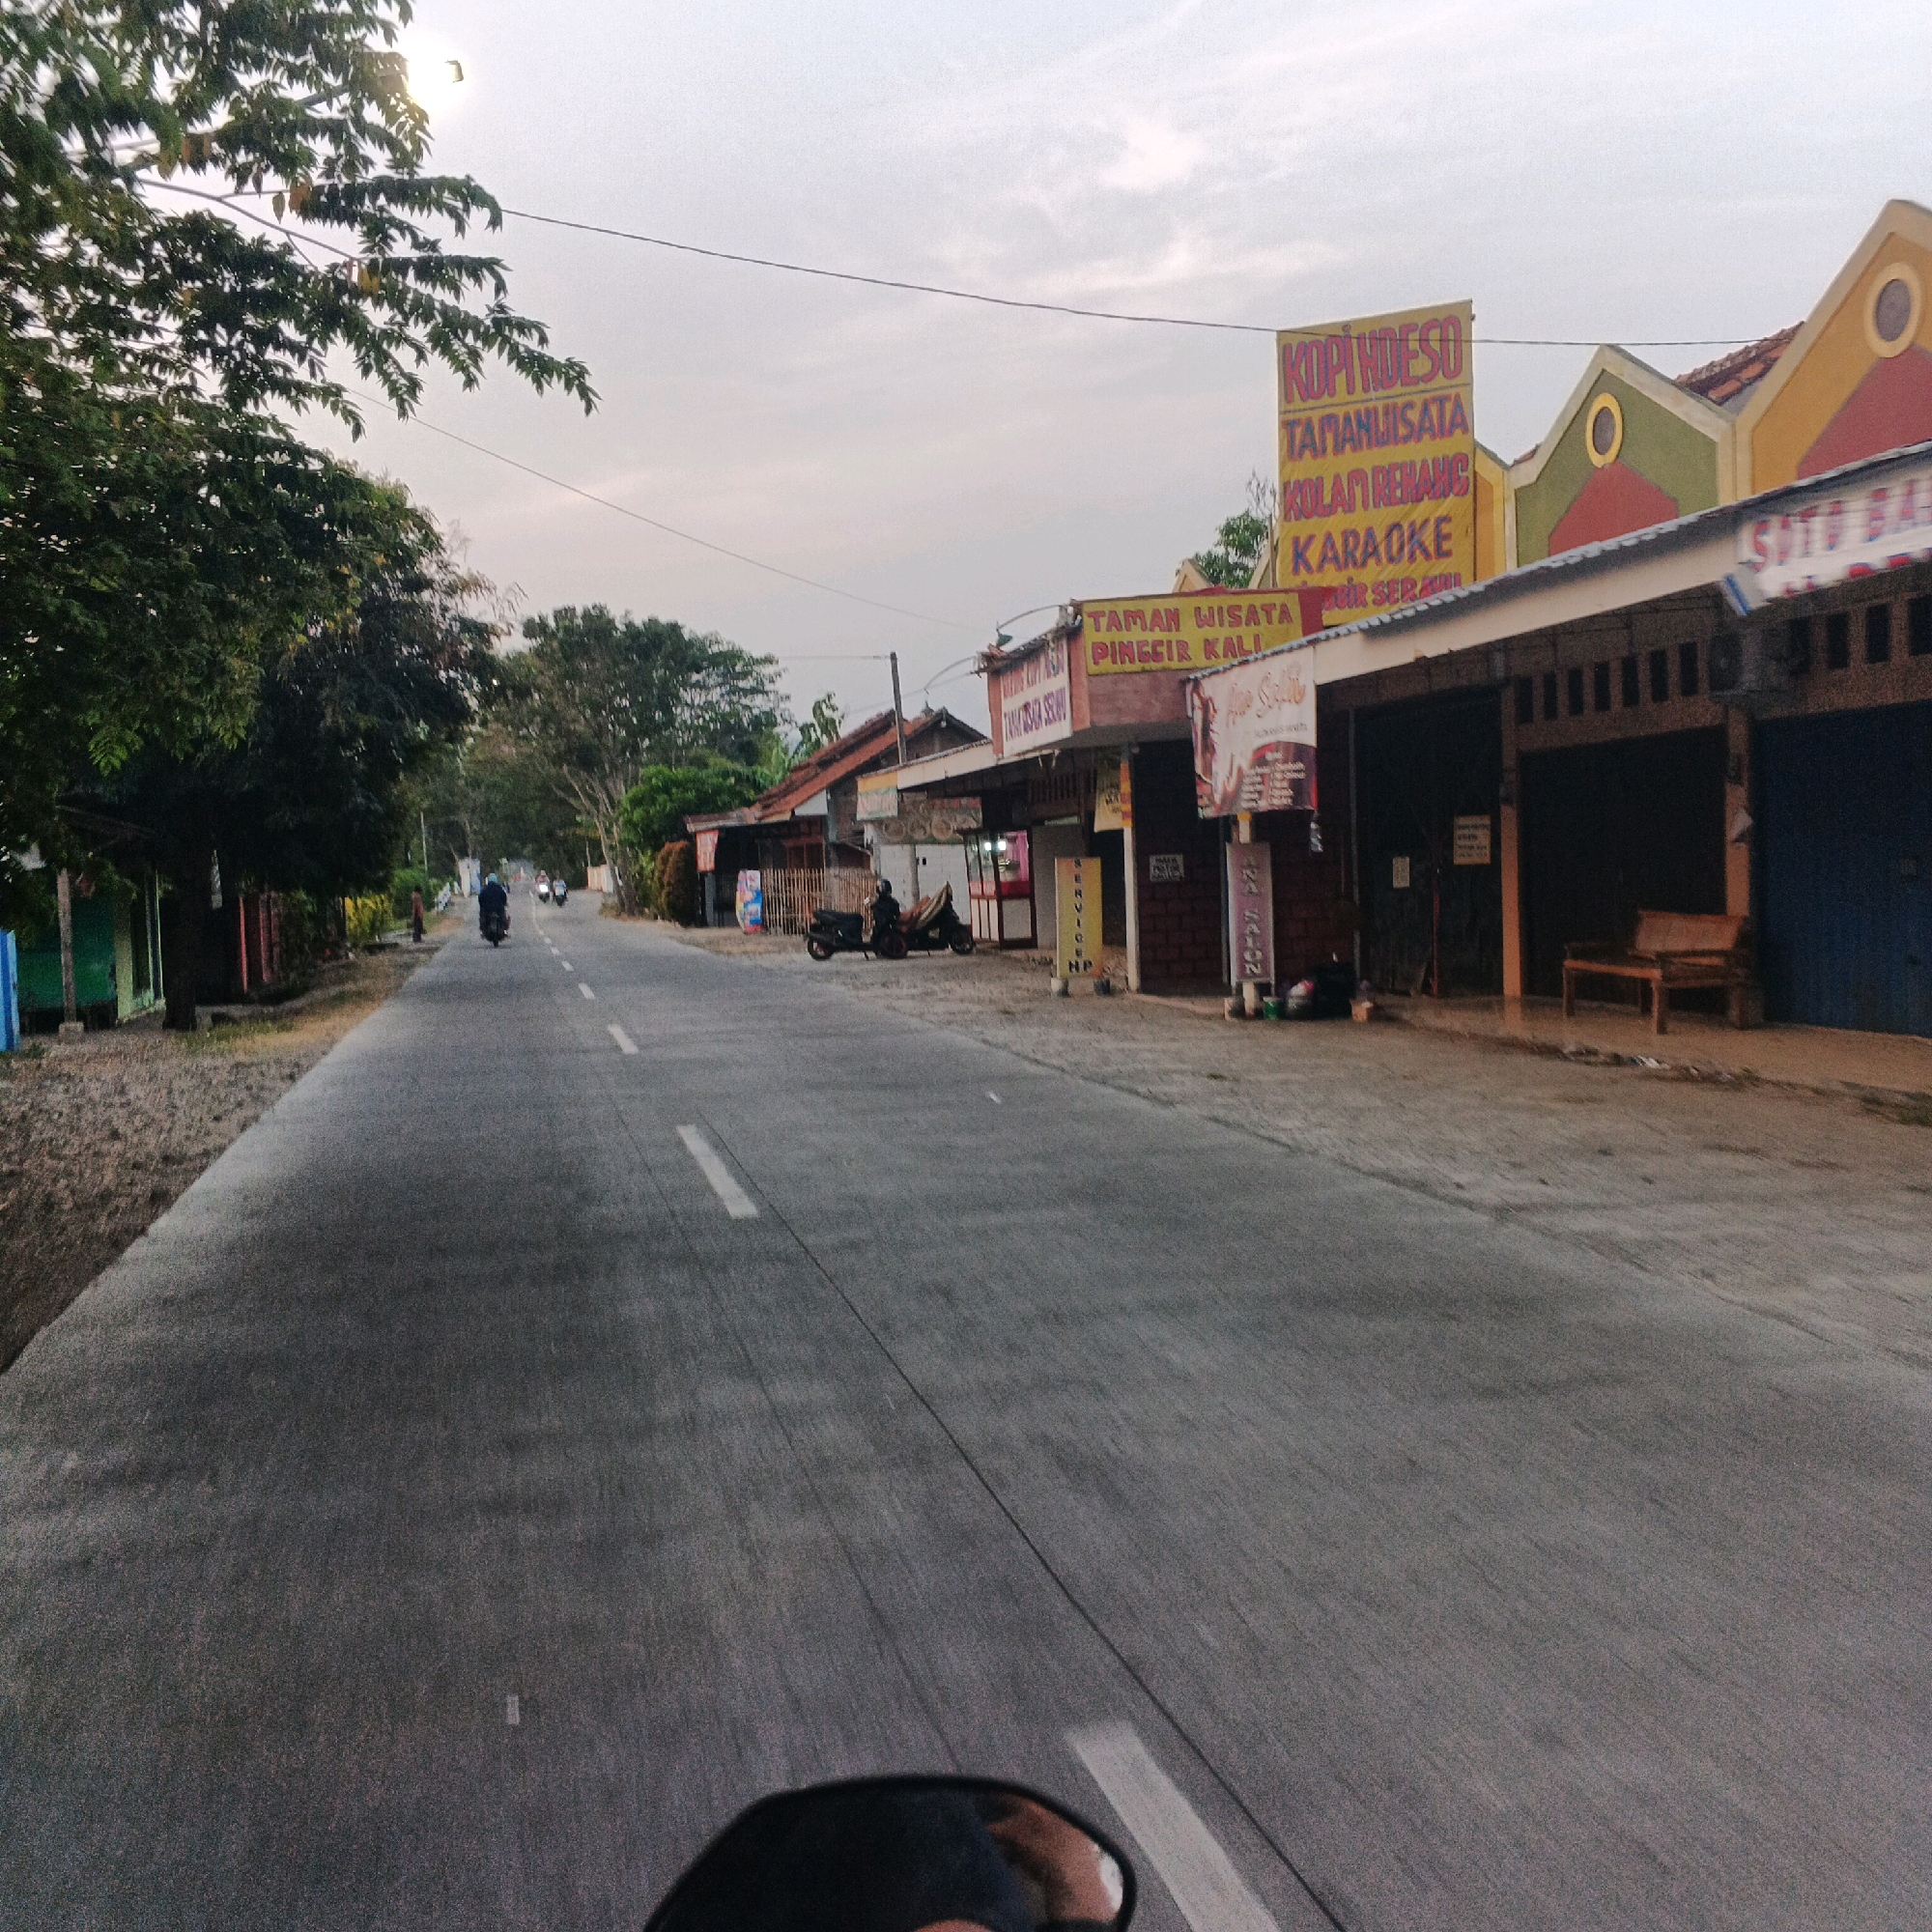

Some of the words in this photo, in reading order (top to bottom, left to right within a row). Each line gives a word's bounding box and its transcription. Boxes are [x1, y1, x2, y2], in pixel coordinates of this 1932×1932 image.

[1283, 324, 1355, 404] KOPI
[1356, 315, 1463, 394] NDESO
[1283, 468, 1370, 522] KOLAM
[1371, 452, 1469, 509] RENANG
[1291, 515, 1453, 576] KARAOKE
[1087, 608, 1179, 633] TAMAN
[1194, 603, 1293, 629] WISATA
[1092, 639, 1192, 666] PINGGIR
[1204, 634, 1262, 660] KALI
[1068, 959, 1094, 974] HP
[1242, 908, 1264, 977] SALON
